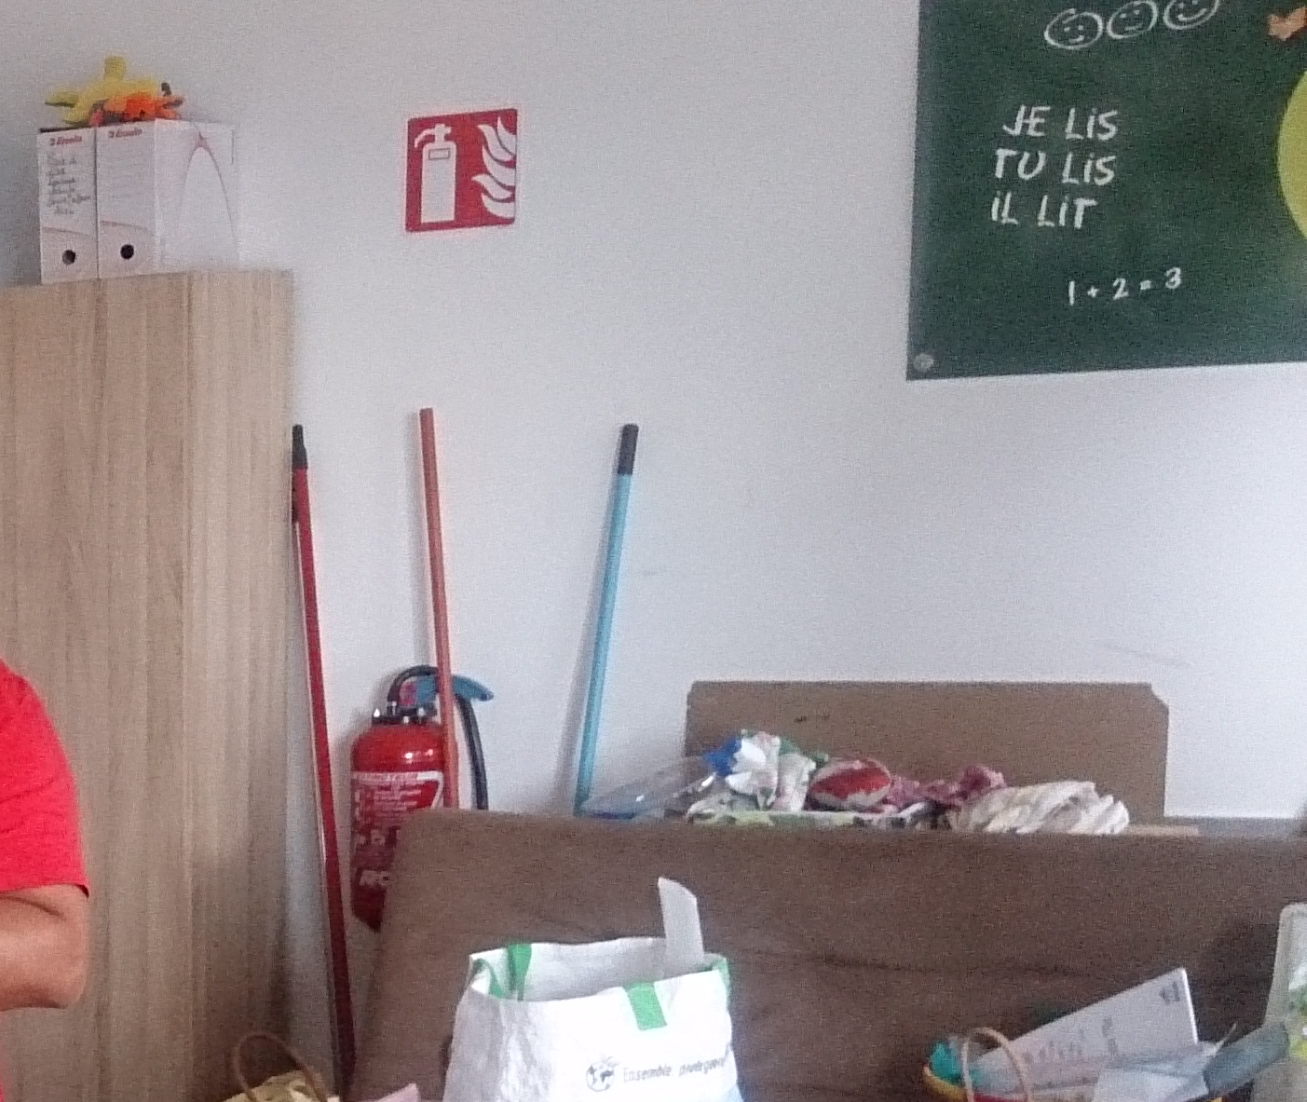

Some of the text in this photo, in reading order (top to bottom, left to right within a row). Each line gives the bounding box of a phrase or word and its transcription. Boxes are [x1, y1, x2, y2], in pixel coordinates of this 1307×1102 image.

[1002, 104, 1051, 137] JE
[995, 148, 1047, 181] TU
[1067, 280, 1076, 306] 1
[1112, 278, 1129, 300] 2
[1164, 267, 1182, 289] 3
